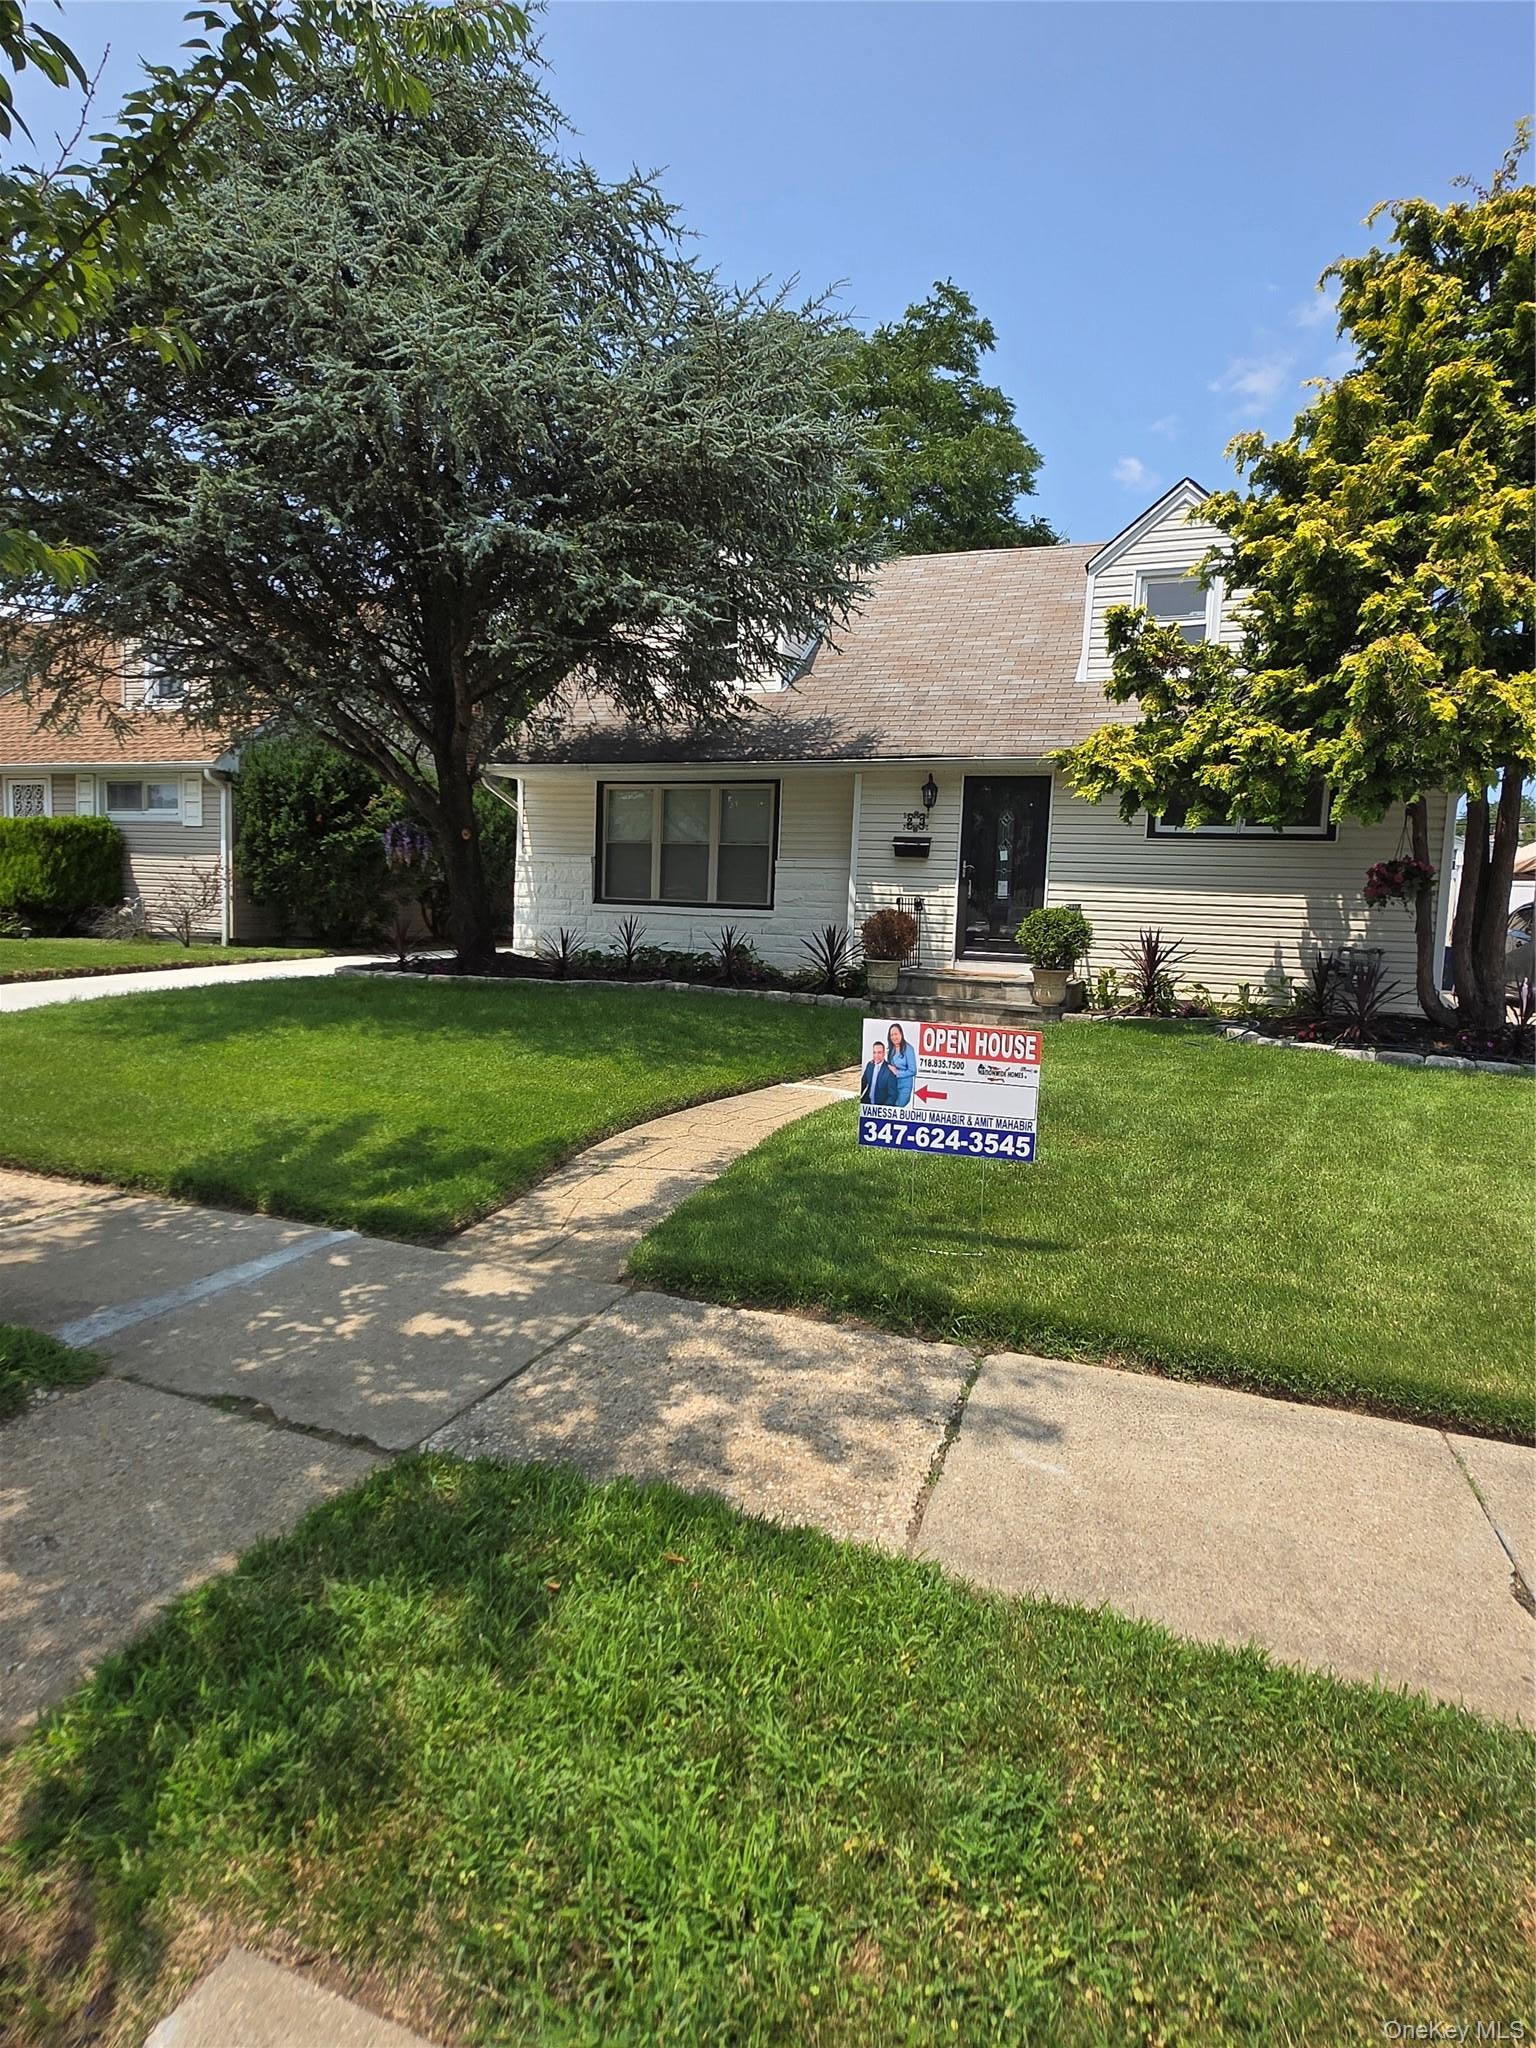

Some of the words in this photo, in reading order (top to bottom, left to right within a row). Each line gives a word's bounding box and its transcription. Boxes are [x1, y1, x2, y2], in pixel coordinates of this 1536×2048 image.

[923, 1027, 969, 1055] OPEN
[975, 1031, 1037, 1060] HOUSE
[920, 1058, 965, 1070] 718.835.7500
[862, 1105, 897, 1119] VANESSA
[899, 1109, 927, 1122] BUDHU
[928, 1113, 965, 1126] MAHABIR
[967, 1115, 973, 1126] &
[974, 1117, 994, 1129] AMIT
[995, 1119, 1033, 1132] MAHABIR
[863, 1121, 1031, 1157] 347-624-3545
